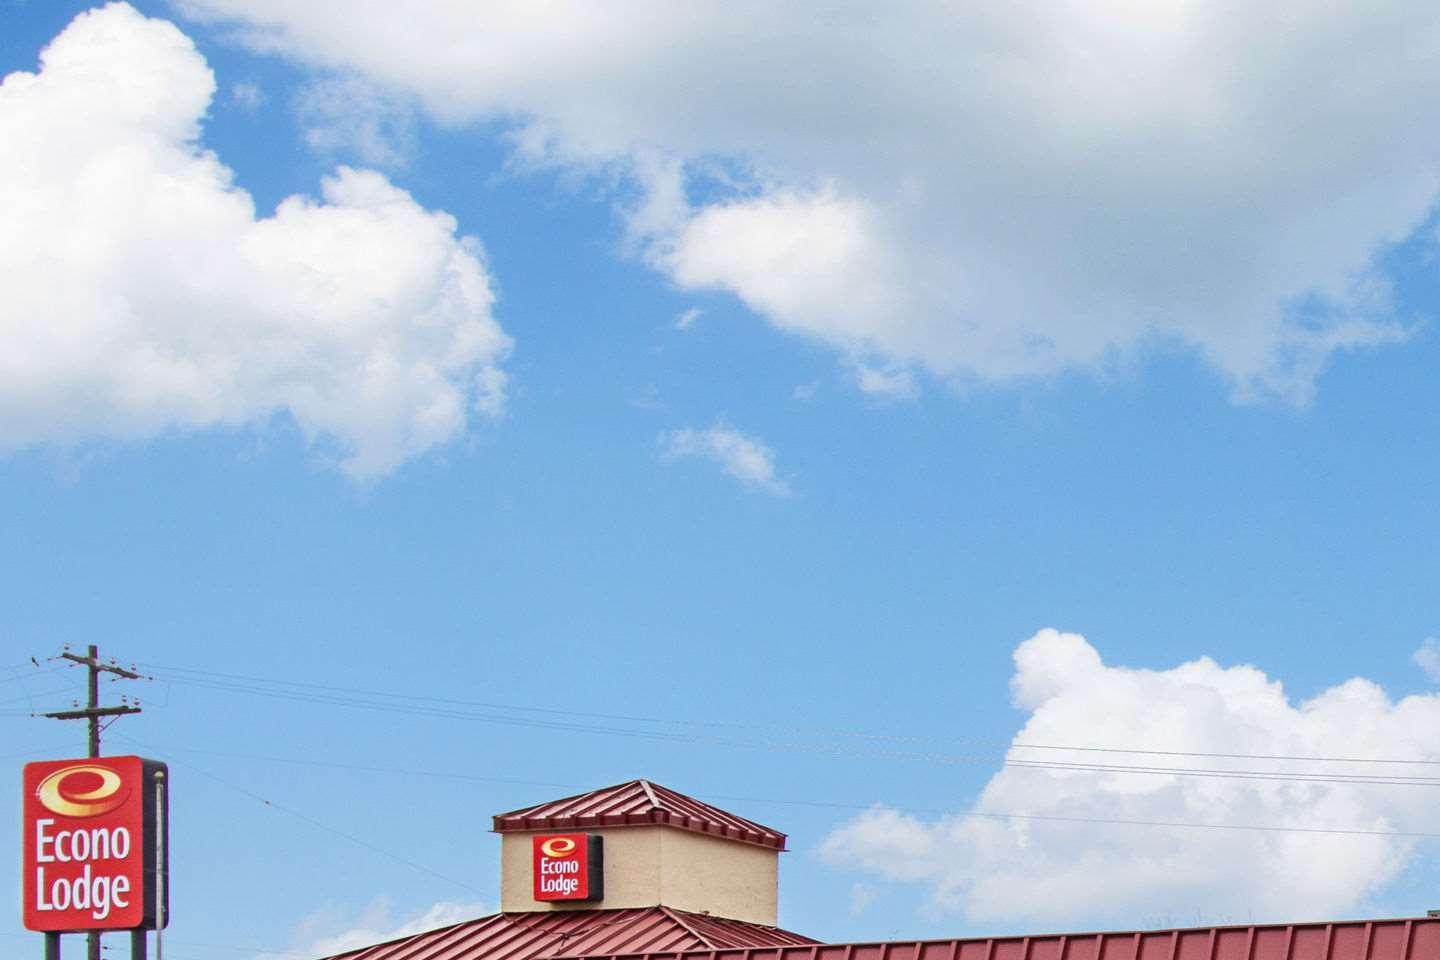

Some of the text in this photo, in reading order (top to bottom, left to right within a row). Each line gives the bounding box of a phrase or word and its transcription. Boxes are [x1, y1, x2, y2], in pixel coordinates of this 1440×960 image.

[36, 818, 130, 862] Econo
[541, 857, 579, 874] Econo
[36, 864, 130, 920] Lodge
[541, 874, 579, 896] Lodge
